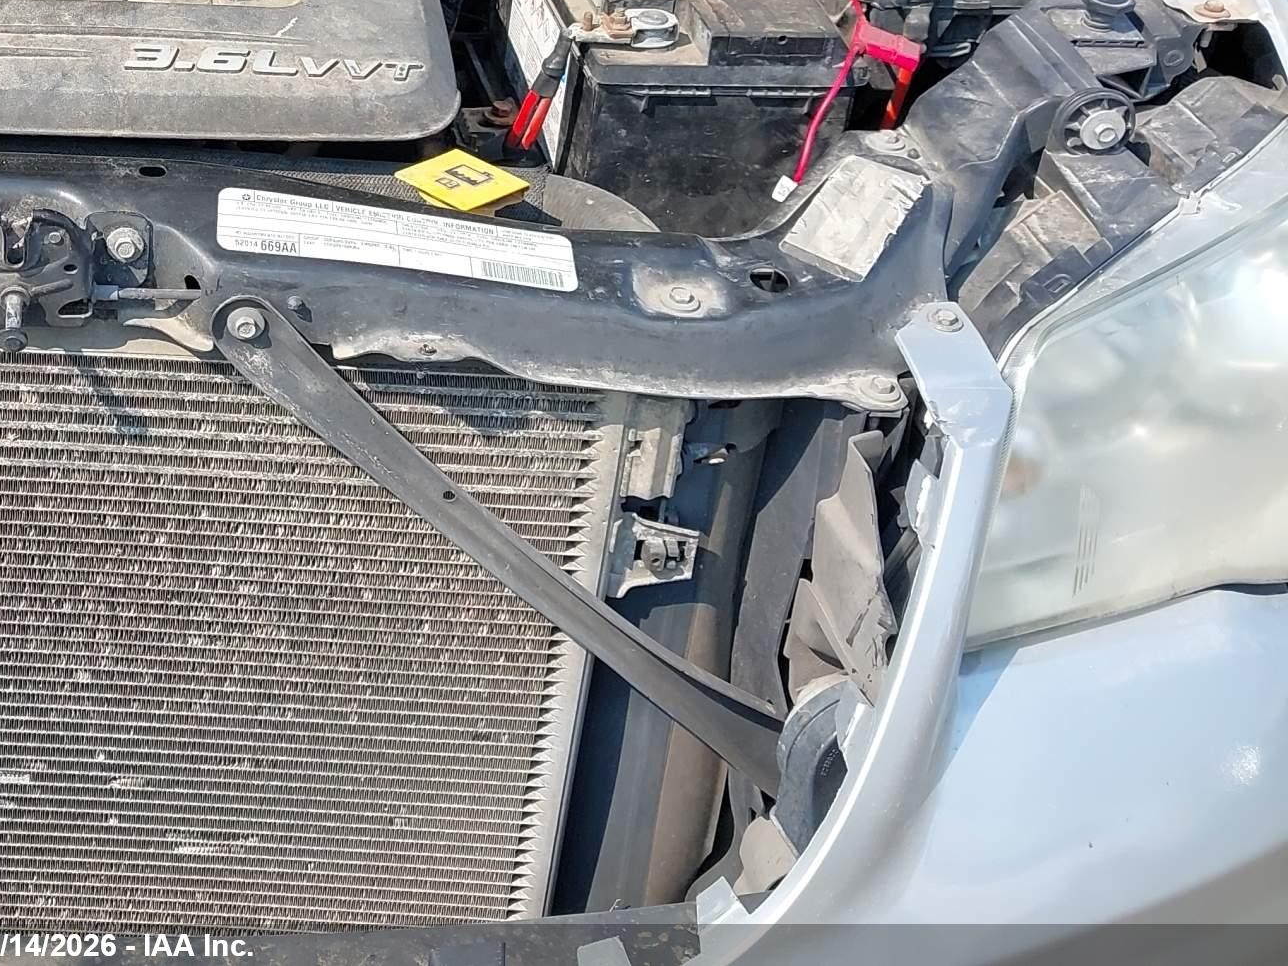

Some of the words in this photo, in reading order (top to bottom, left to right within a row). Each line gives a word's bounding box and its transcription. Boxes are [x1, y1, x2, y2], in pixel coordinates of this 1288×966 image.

[256, 194, 288, 204] Chrysler
[289, 198, 313, 209] Group
[335, 205, 365, 216] VEHICLE
[443, 222, 494, 234] INFORMATION
[261, 240, 297, 254] 669AA
